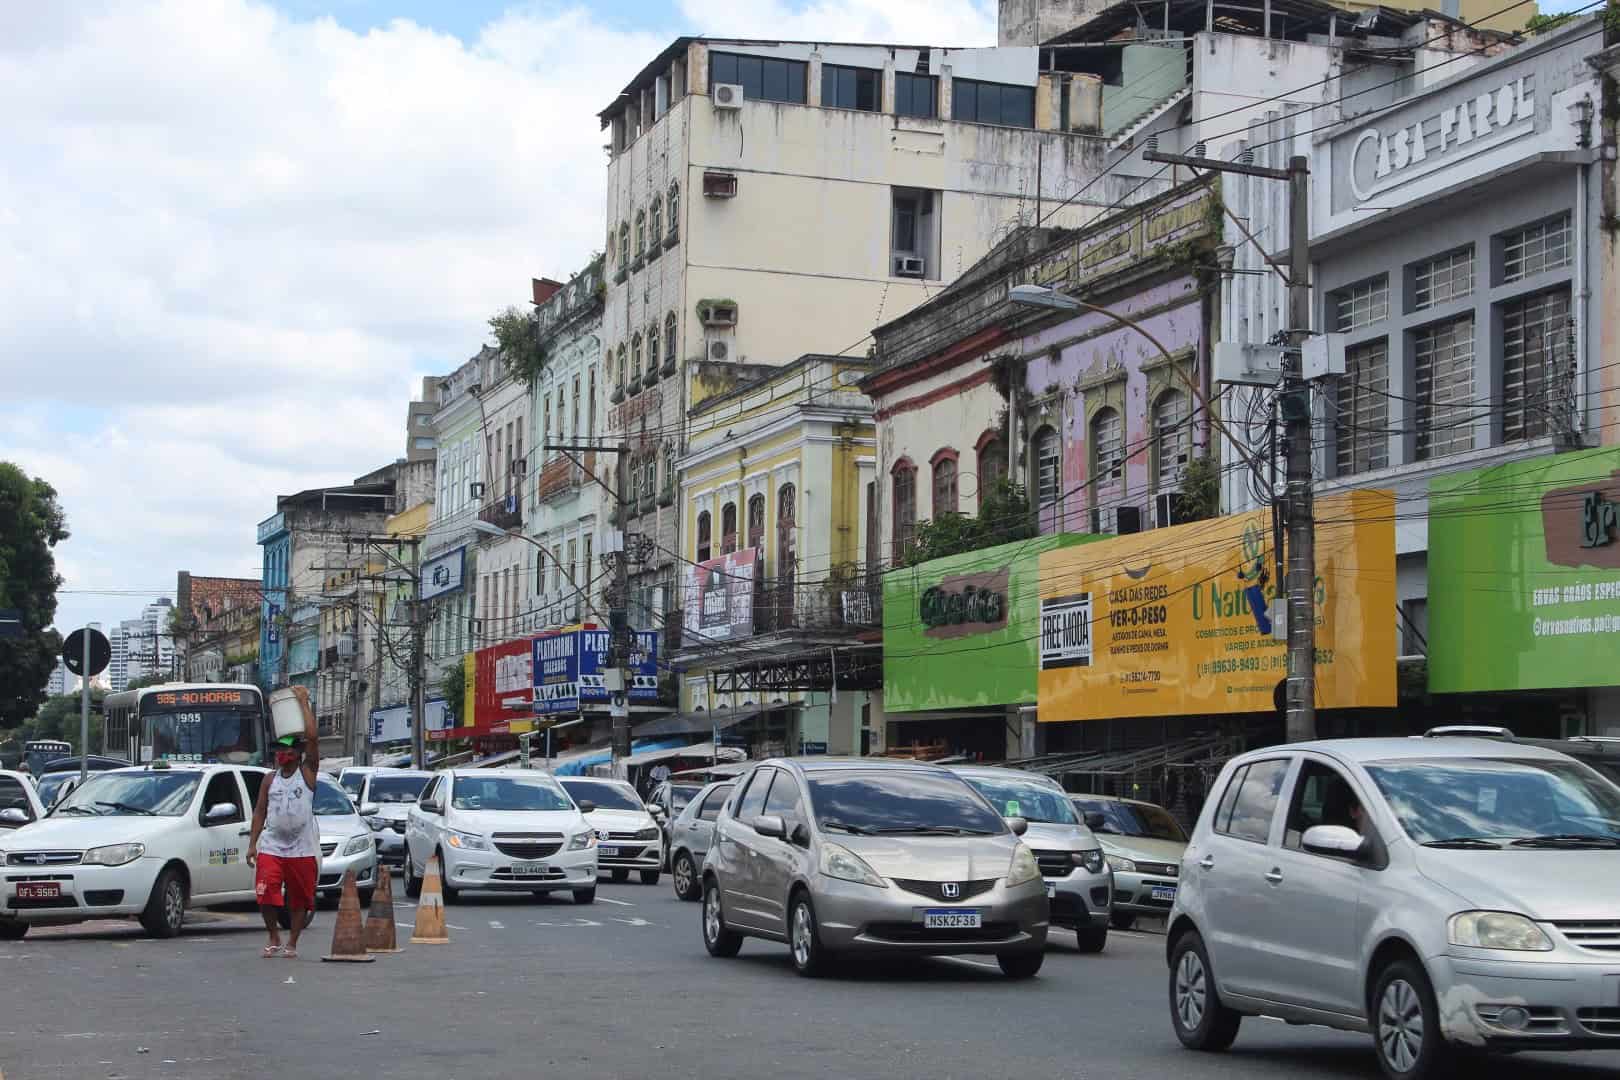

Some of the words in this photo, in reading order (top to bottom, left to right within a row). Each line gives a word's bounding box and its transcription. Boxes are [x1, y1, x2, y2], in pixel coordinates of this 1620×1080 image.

[1109, 589, 1127, 604] CASA
[1144, 585, 1168, 599] REDES
[1110, 605, 1167, 627] VER-O-PESO
[1042, 614, 1061, 651] FREE
[1062, 609, 1089, 649] MODA
[199, 690, 241, 704] HORAS
